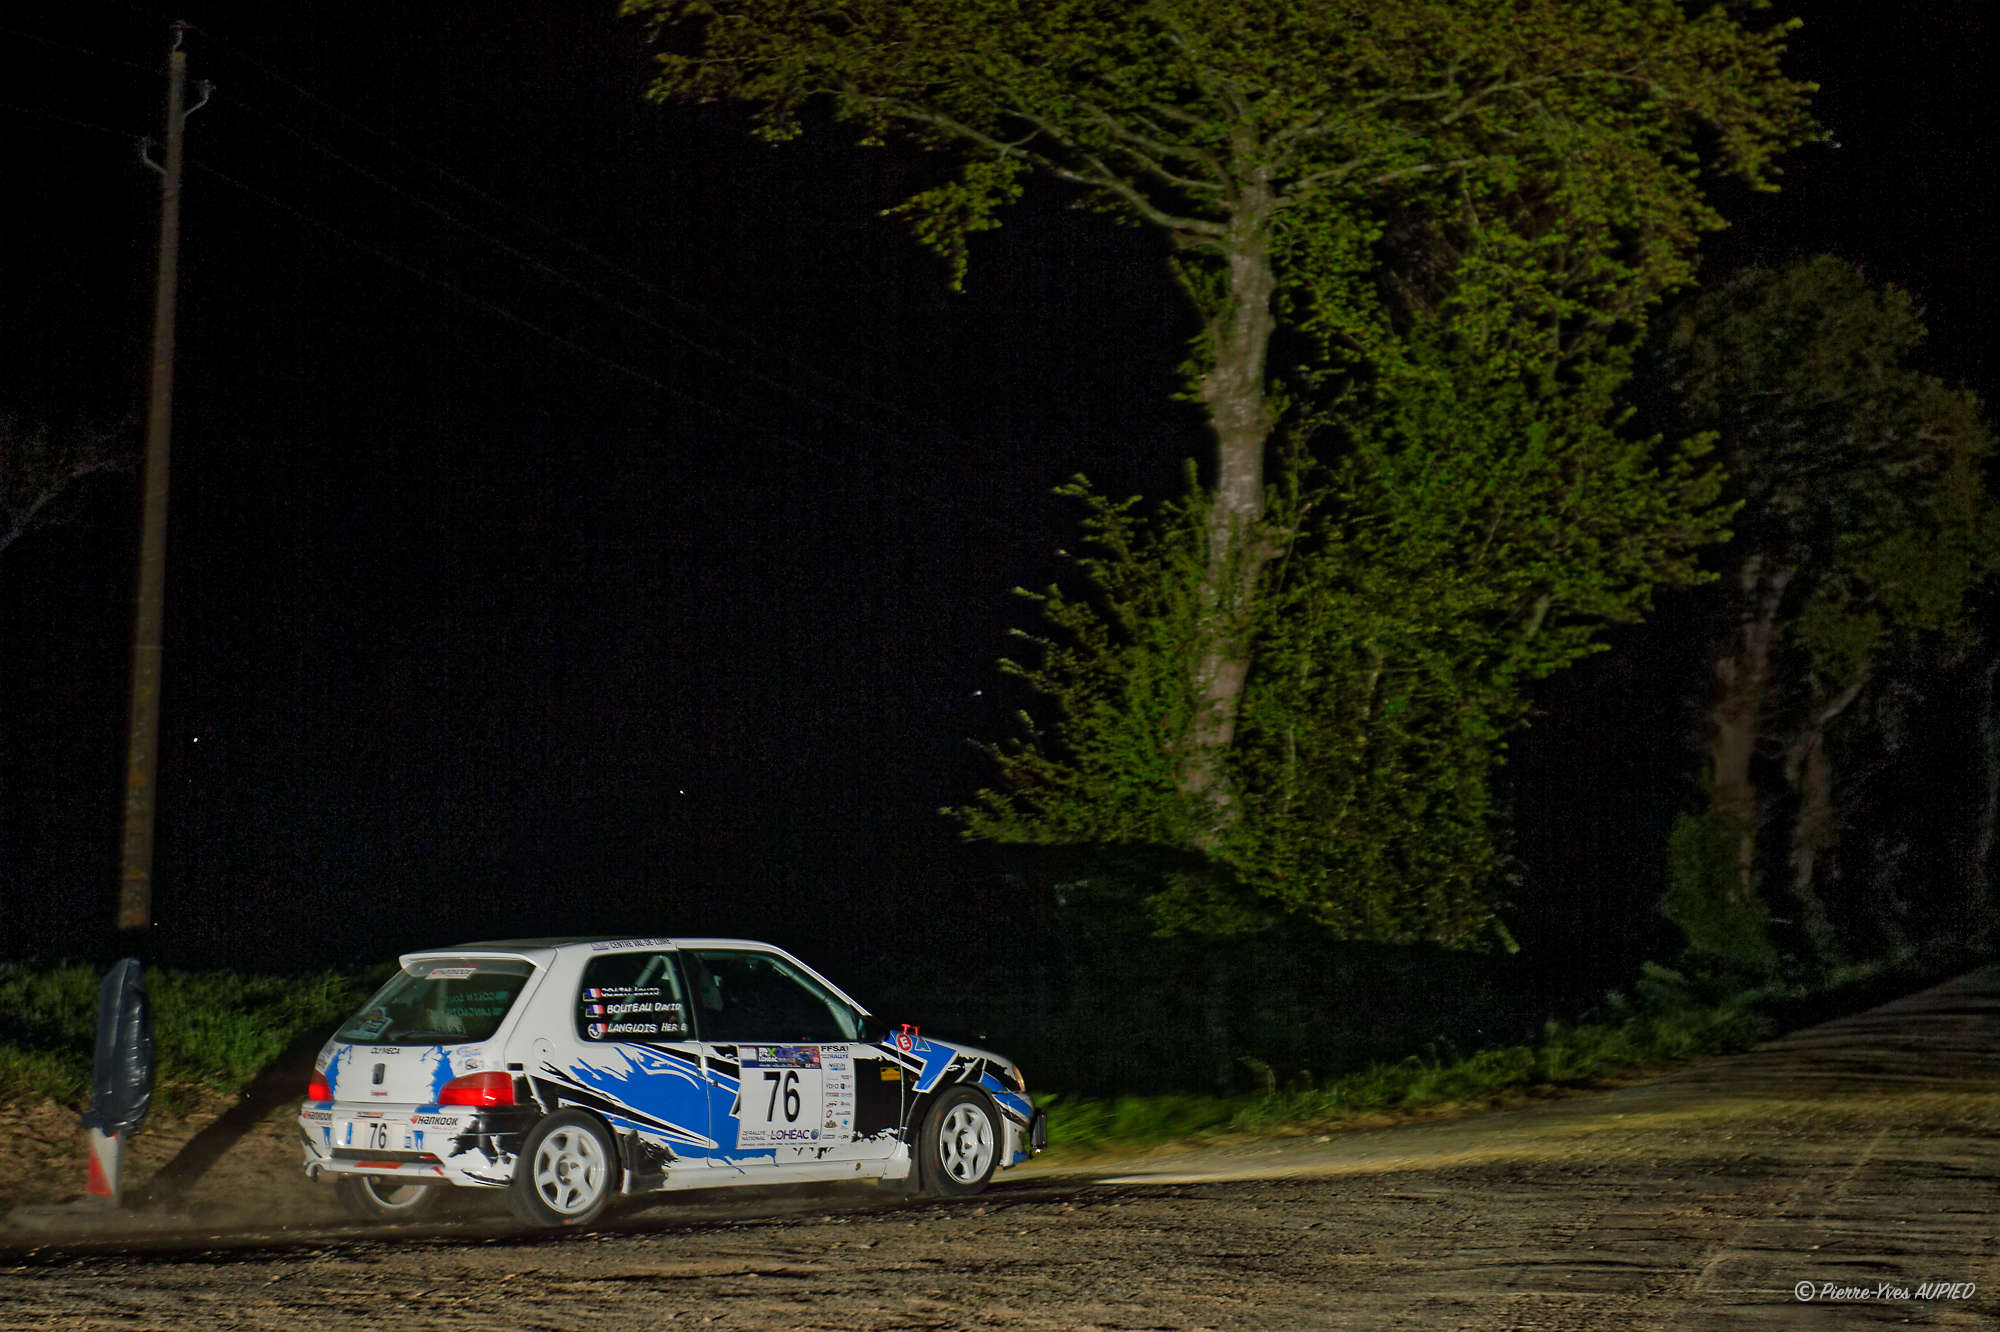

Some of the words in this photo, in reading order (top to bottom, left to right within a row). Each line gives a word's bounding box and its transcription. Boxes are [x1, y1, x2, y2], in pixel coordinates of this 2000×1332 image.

[607, 1003, 652, 1014] BOUTEAU
[608, 1023, 657, 1033] LANGLOIS
[902, 1036, 911, 1048] E
[763, 1070, 800, 1123] 76
[370, 1122, 387, 1149] 76
[770, 1127, 810, 1140] LOHÉAC
